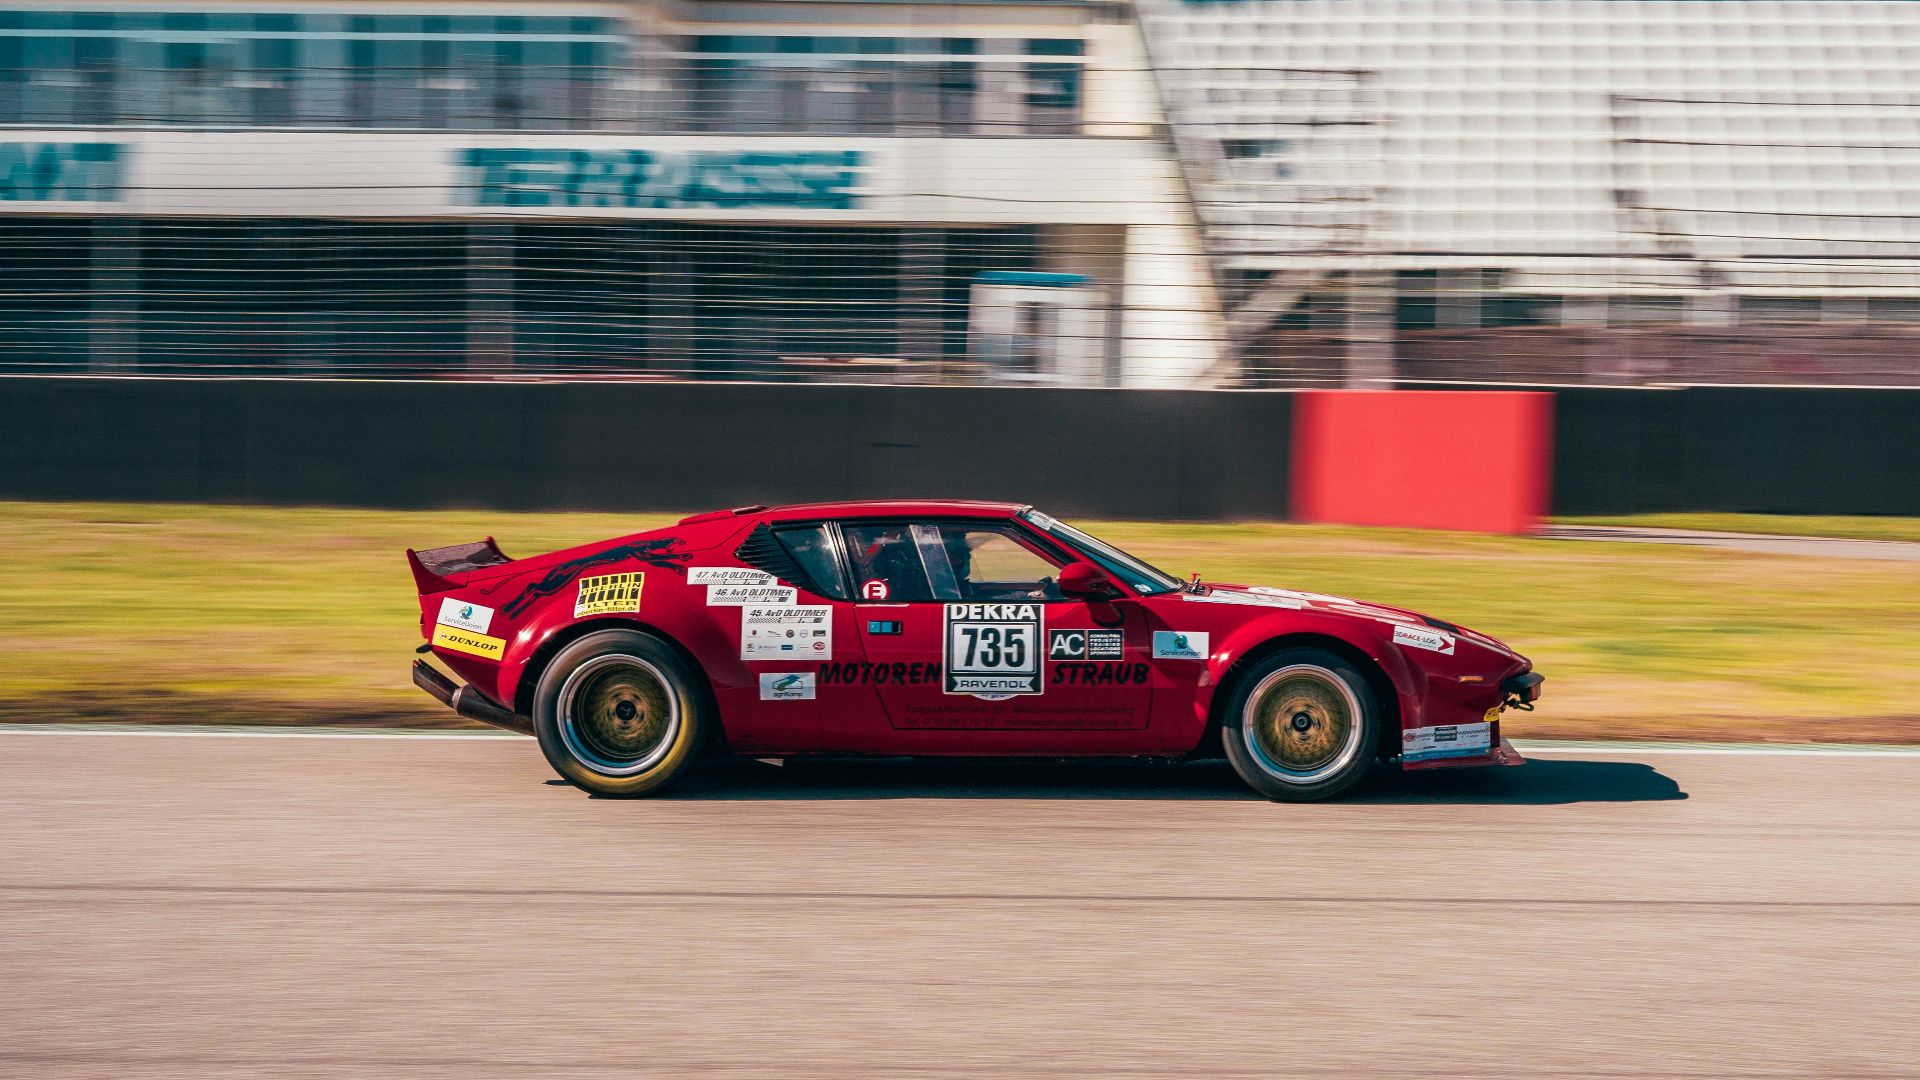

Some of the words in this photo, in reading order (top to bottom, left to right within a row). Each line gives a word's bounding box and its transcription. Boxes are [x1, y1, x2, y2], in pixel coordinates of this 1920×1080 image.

[730, 588, 747, 596] AvD
[748, 588, 793, 597] OLDTIMER
[765, 609, 783, 617] AvD
[783, 609, 827, 617] OLDTIMER
[950, 604, 1037, 620] DEKRA
[444, 616, 483, 630] ServiceUnion
[448, 635, 498, 651] DUNLOP
[961, 627, 1026, 668] 735
[1050, 634, 1085, 656] AC
[818, 662, 942, 685] MOTOREN
[1052, 663, 1149, 687] STRAUB
[960, 680, 1028, 689] RAVENOL
